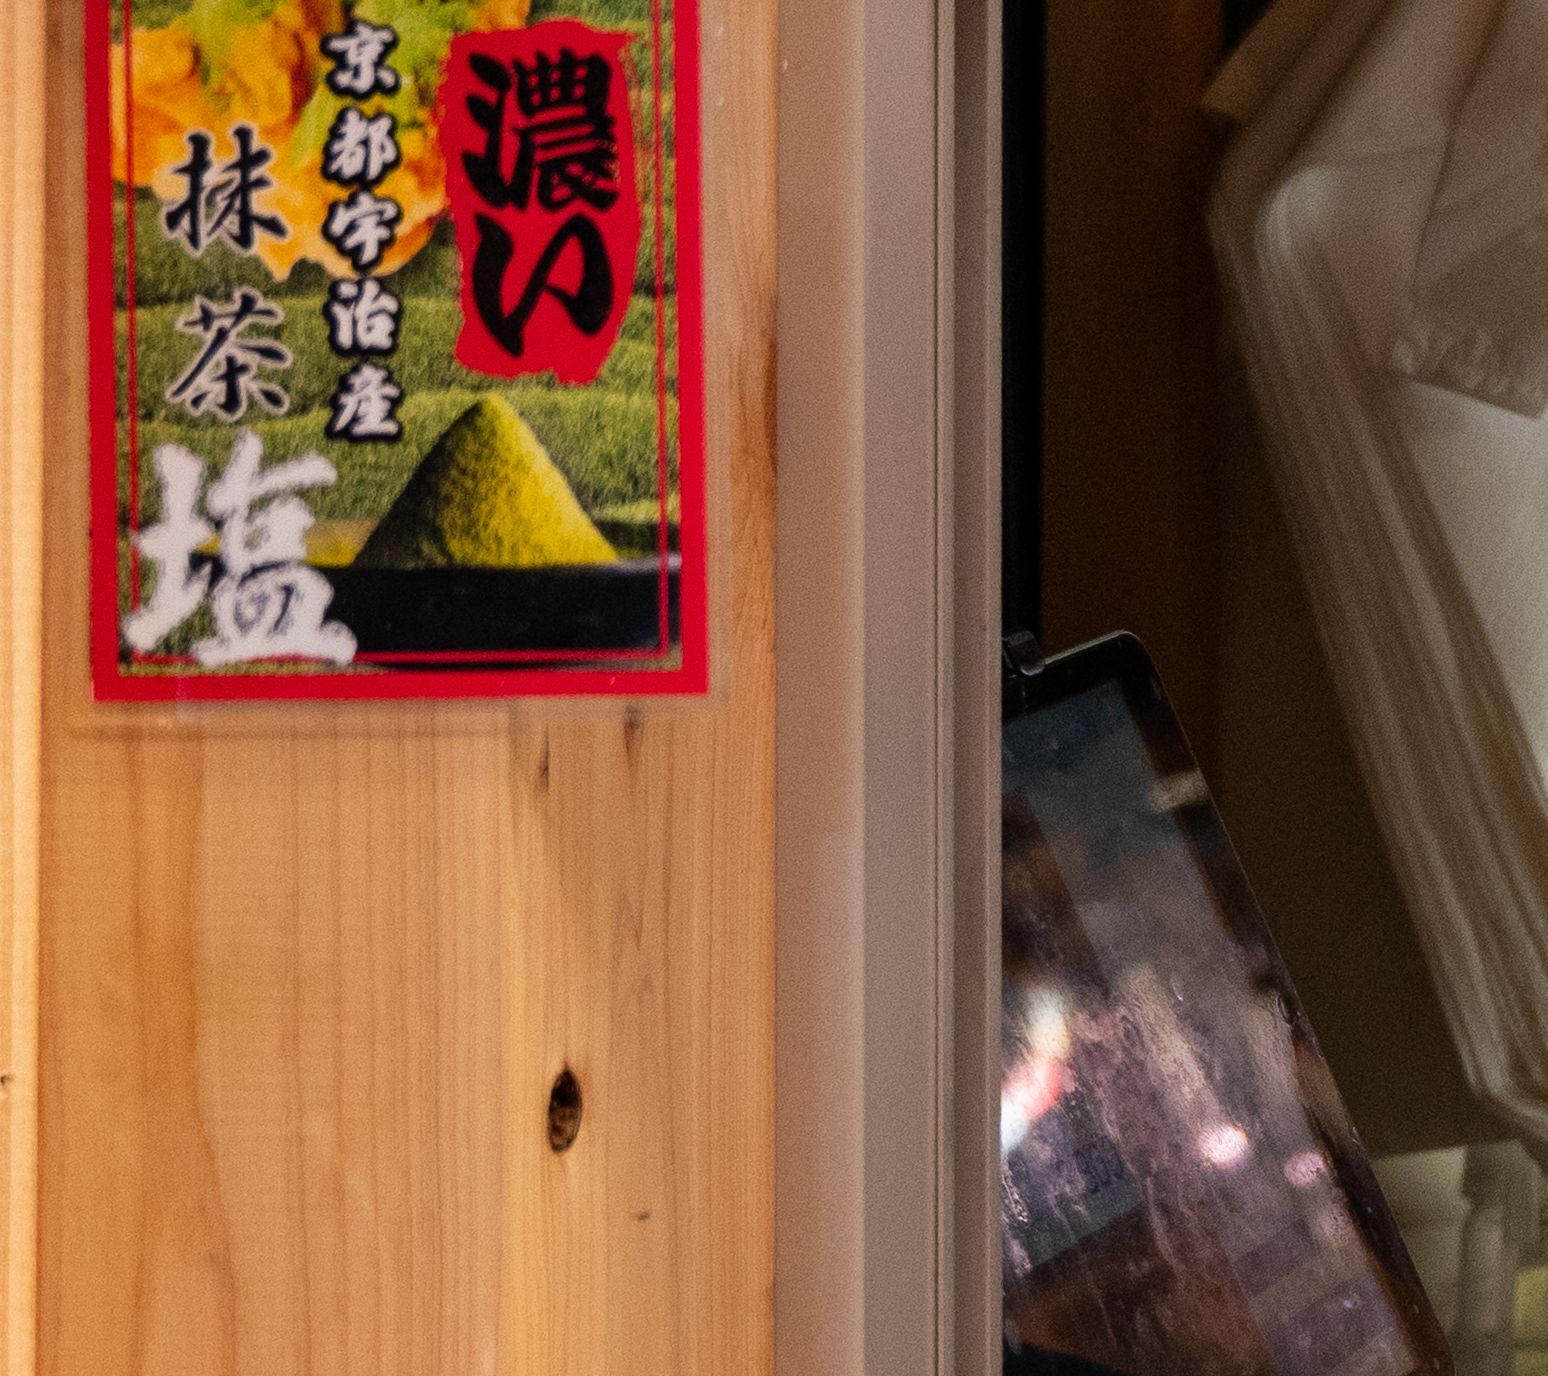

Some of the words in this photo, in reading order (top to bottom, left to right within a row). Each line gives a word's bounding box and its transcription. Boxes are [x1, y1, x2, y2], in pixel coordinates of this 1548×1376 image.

[325, 24, 400, 440] 京都宇治産
[461, 46, 620, 359] 濃い
